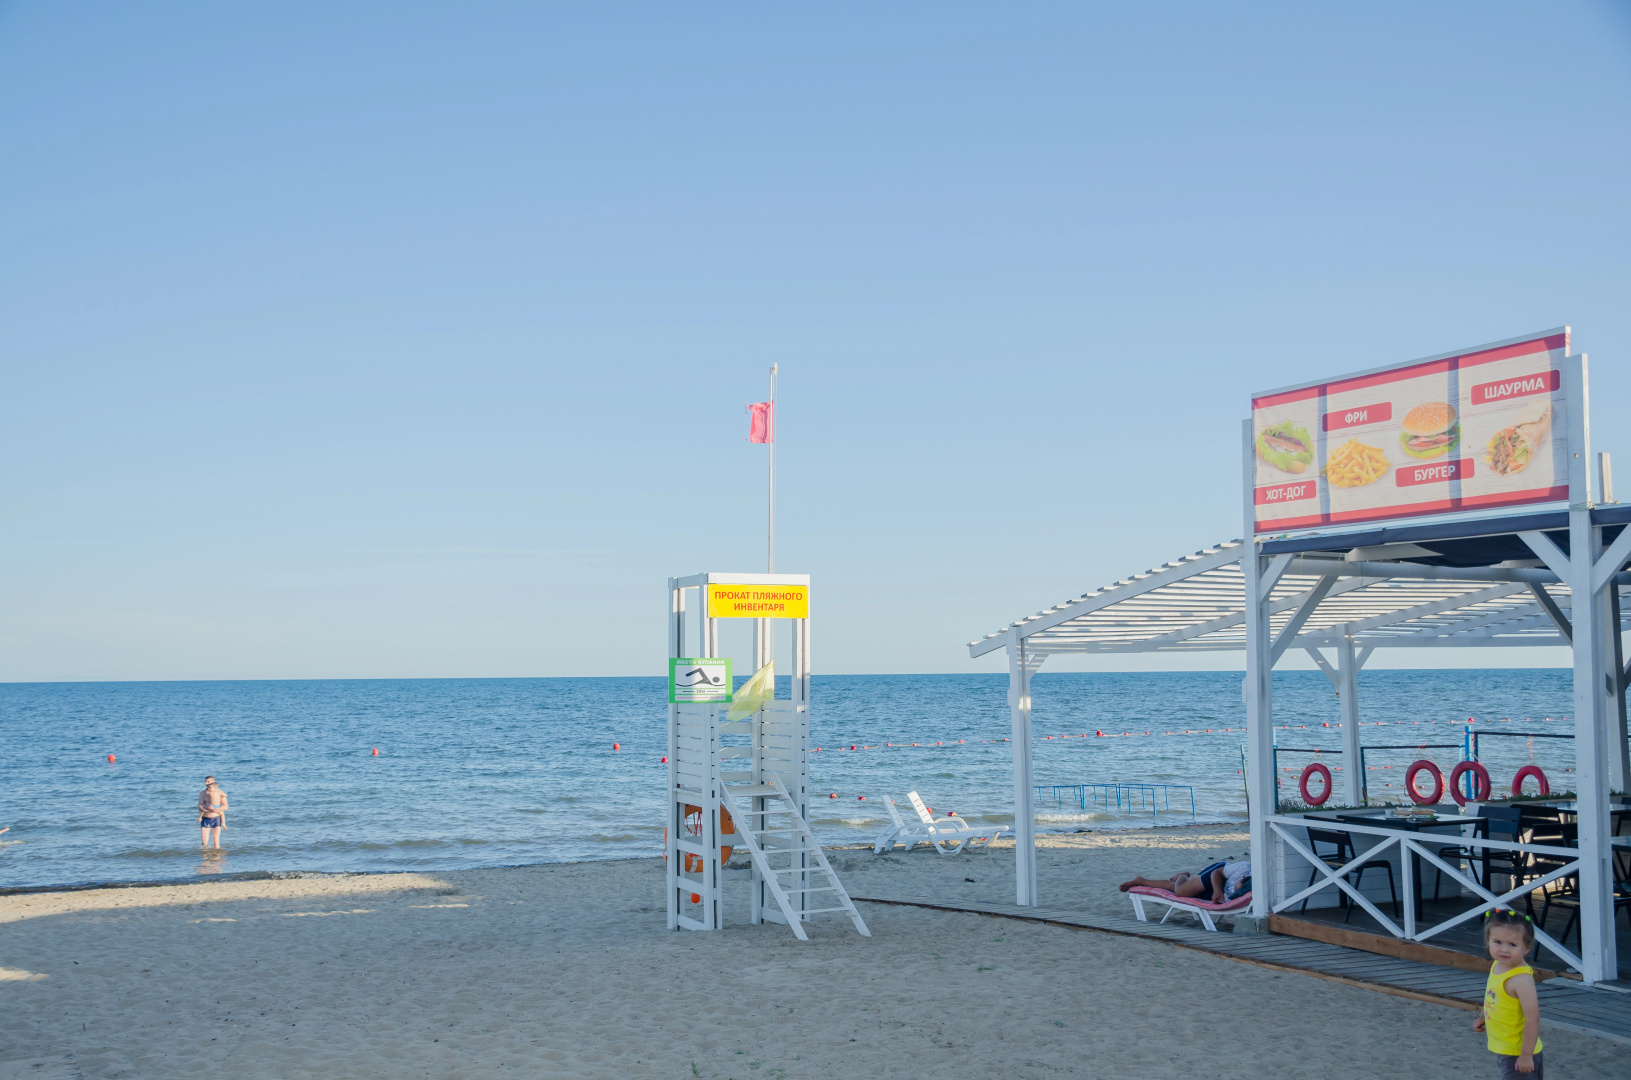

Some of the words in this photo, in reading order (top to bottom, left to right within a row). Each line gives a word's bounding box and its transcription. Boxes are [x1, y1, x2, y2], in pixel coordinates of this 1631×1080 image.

[1484, 377, 1545, 399] ШАУРМА
[1344, 409, 1368, 424] ФРИ
[1414, 465, 1456, 481] БУРГЕР
[1265, 485, 1307, 501] ХОТ-ДОГ
[714, 591, 750, 600] ПРОКАТ
[752, 592, 803, 601] ПЛЯЖНОГО
[734, 602, 785, 611] ИНВЕНТАРЯ
